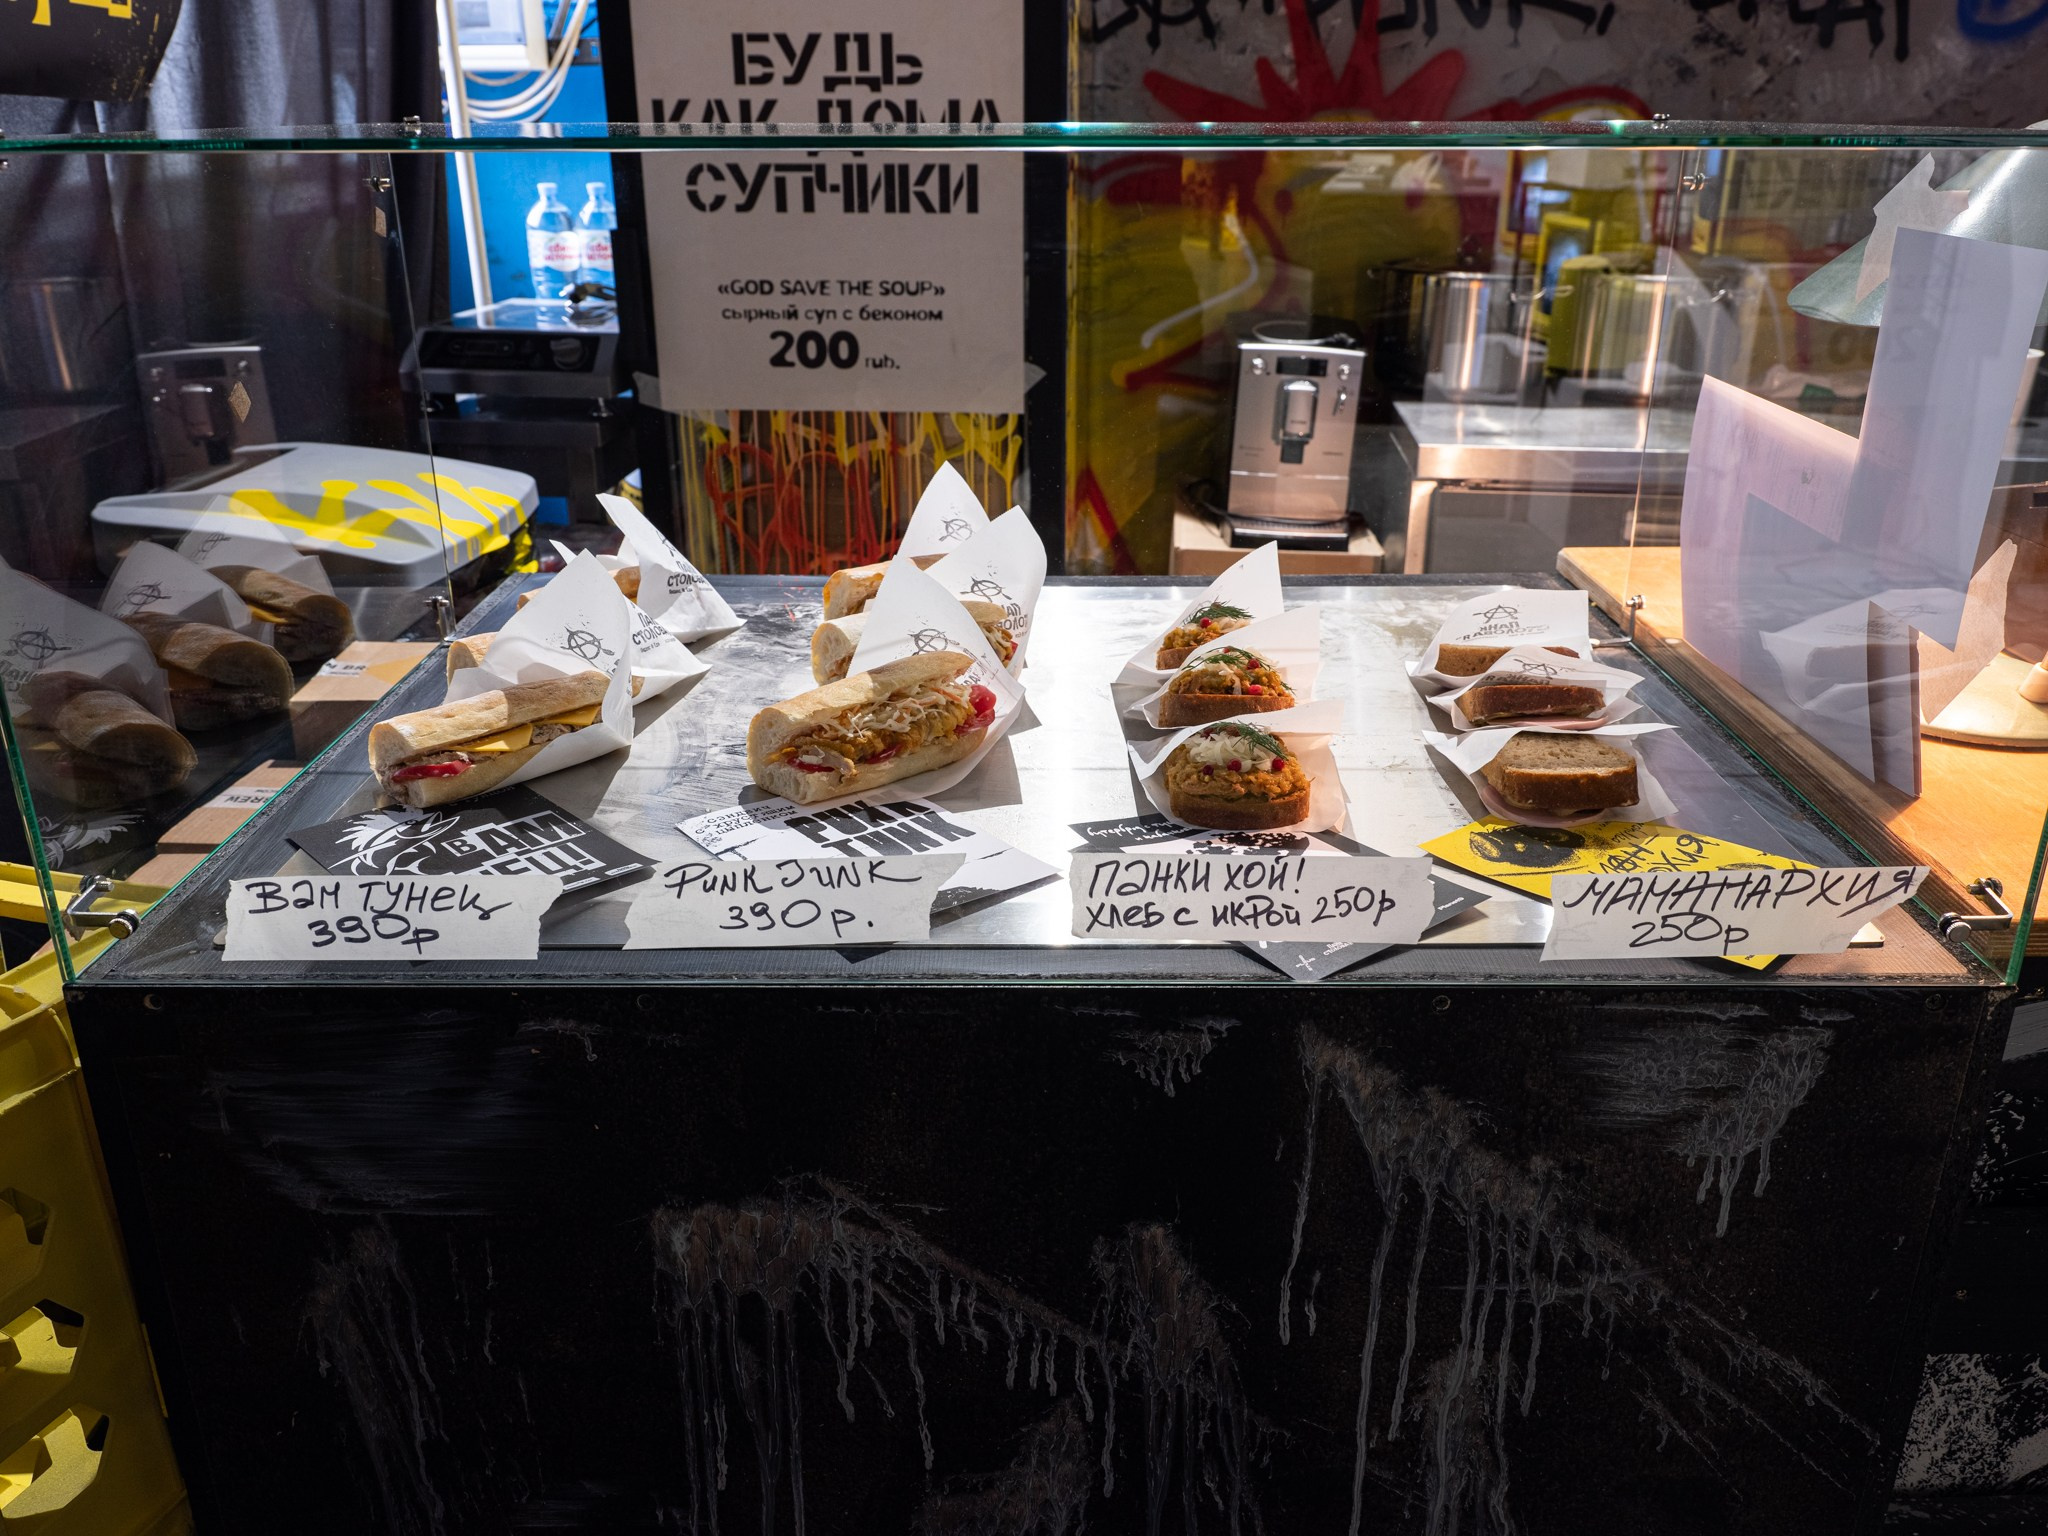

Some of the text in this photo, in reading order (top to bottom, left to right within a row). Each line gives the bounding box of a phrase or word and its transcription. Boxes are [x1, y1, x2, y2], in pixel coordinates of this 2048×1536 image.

[731, 33, 923, 92] БУДЬ
[652, 99, 778, 136] КАК
[686, 163, 979, 213] СУПЧИКИ
[780, 280, 830, 296] SAVE
[836, 280, 873, 296] THE
[721, 303, 943, 324] сырный суп с беконом
[769, 330, 859, 369] 200
